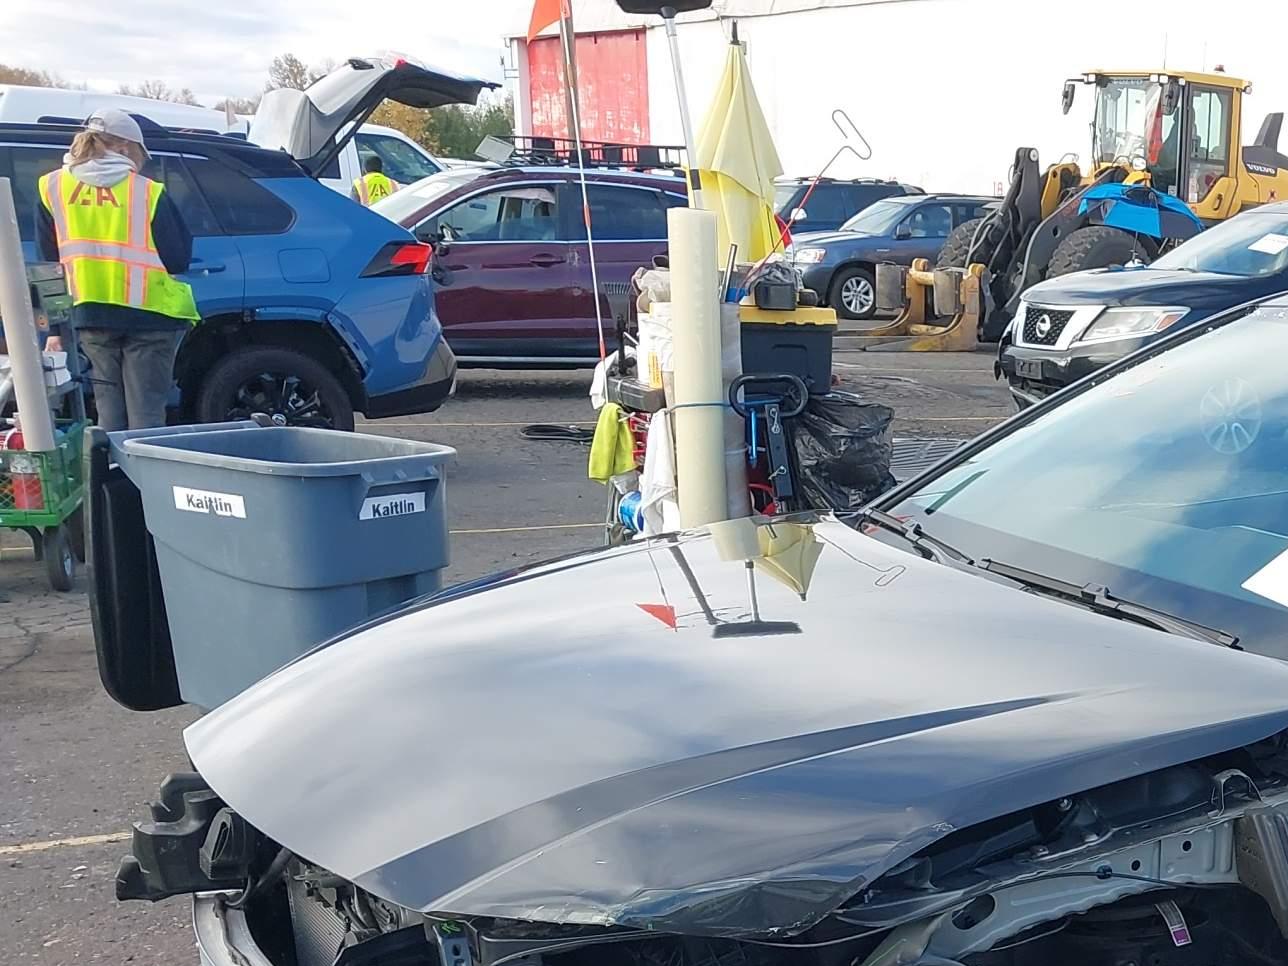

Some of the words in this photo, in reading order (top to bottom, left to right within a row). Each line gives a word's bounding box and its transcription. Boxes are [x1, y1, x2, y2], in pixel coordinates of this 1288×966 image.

[1246, 163, 1276, 175] VOLVO
[186, 494, 233, 514] Kaitlin
[372, 499, 415, 518] Kaitlin
